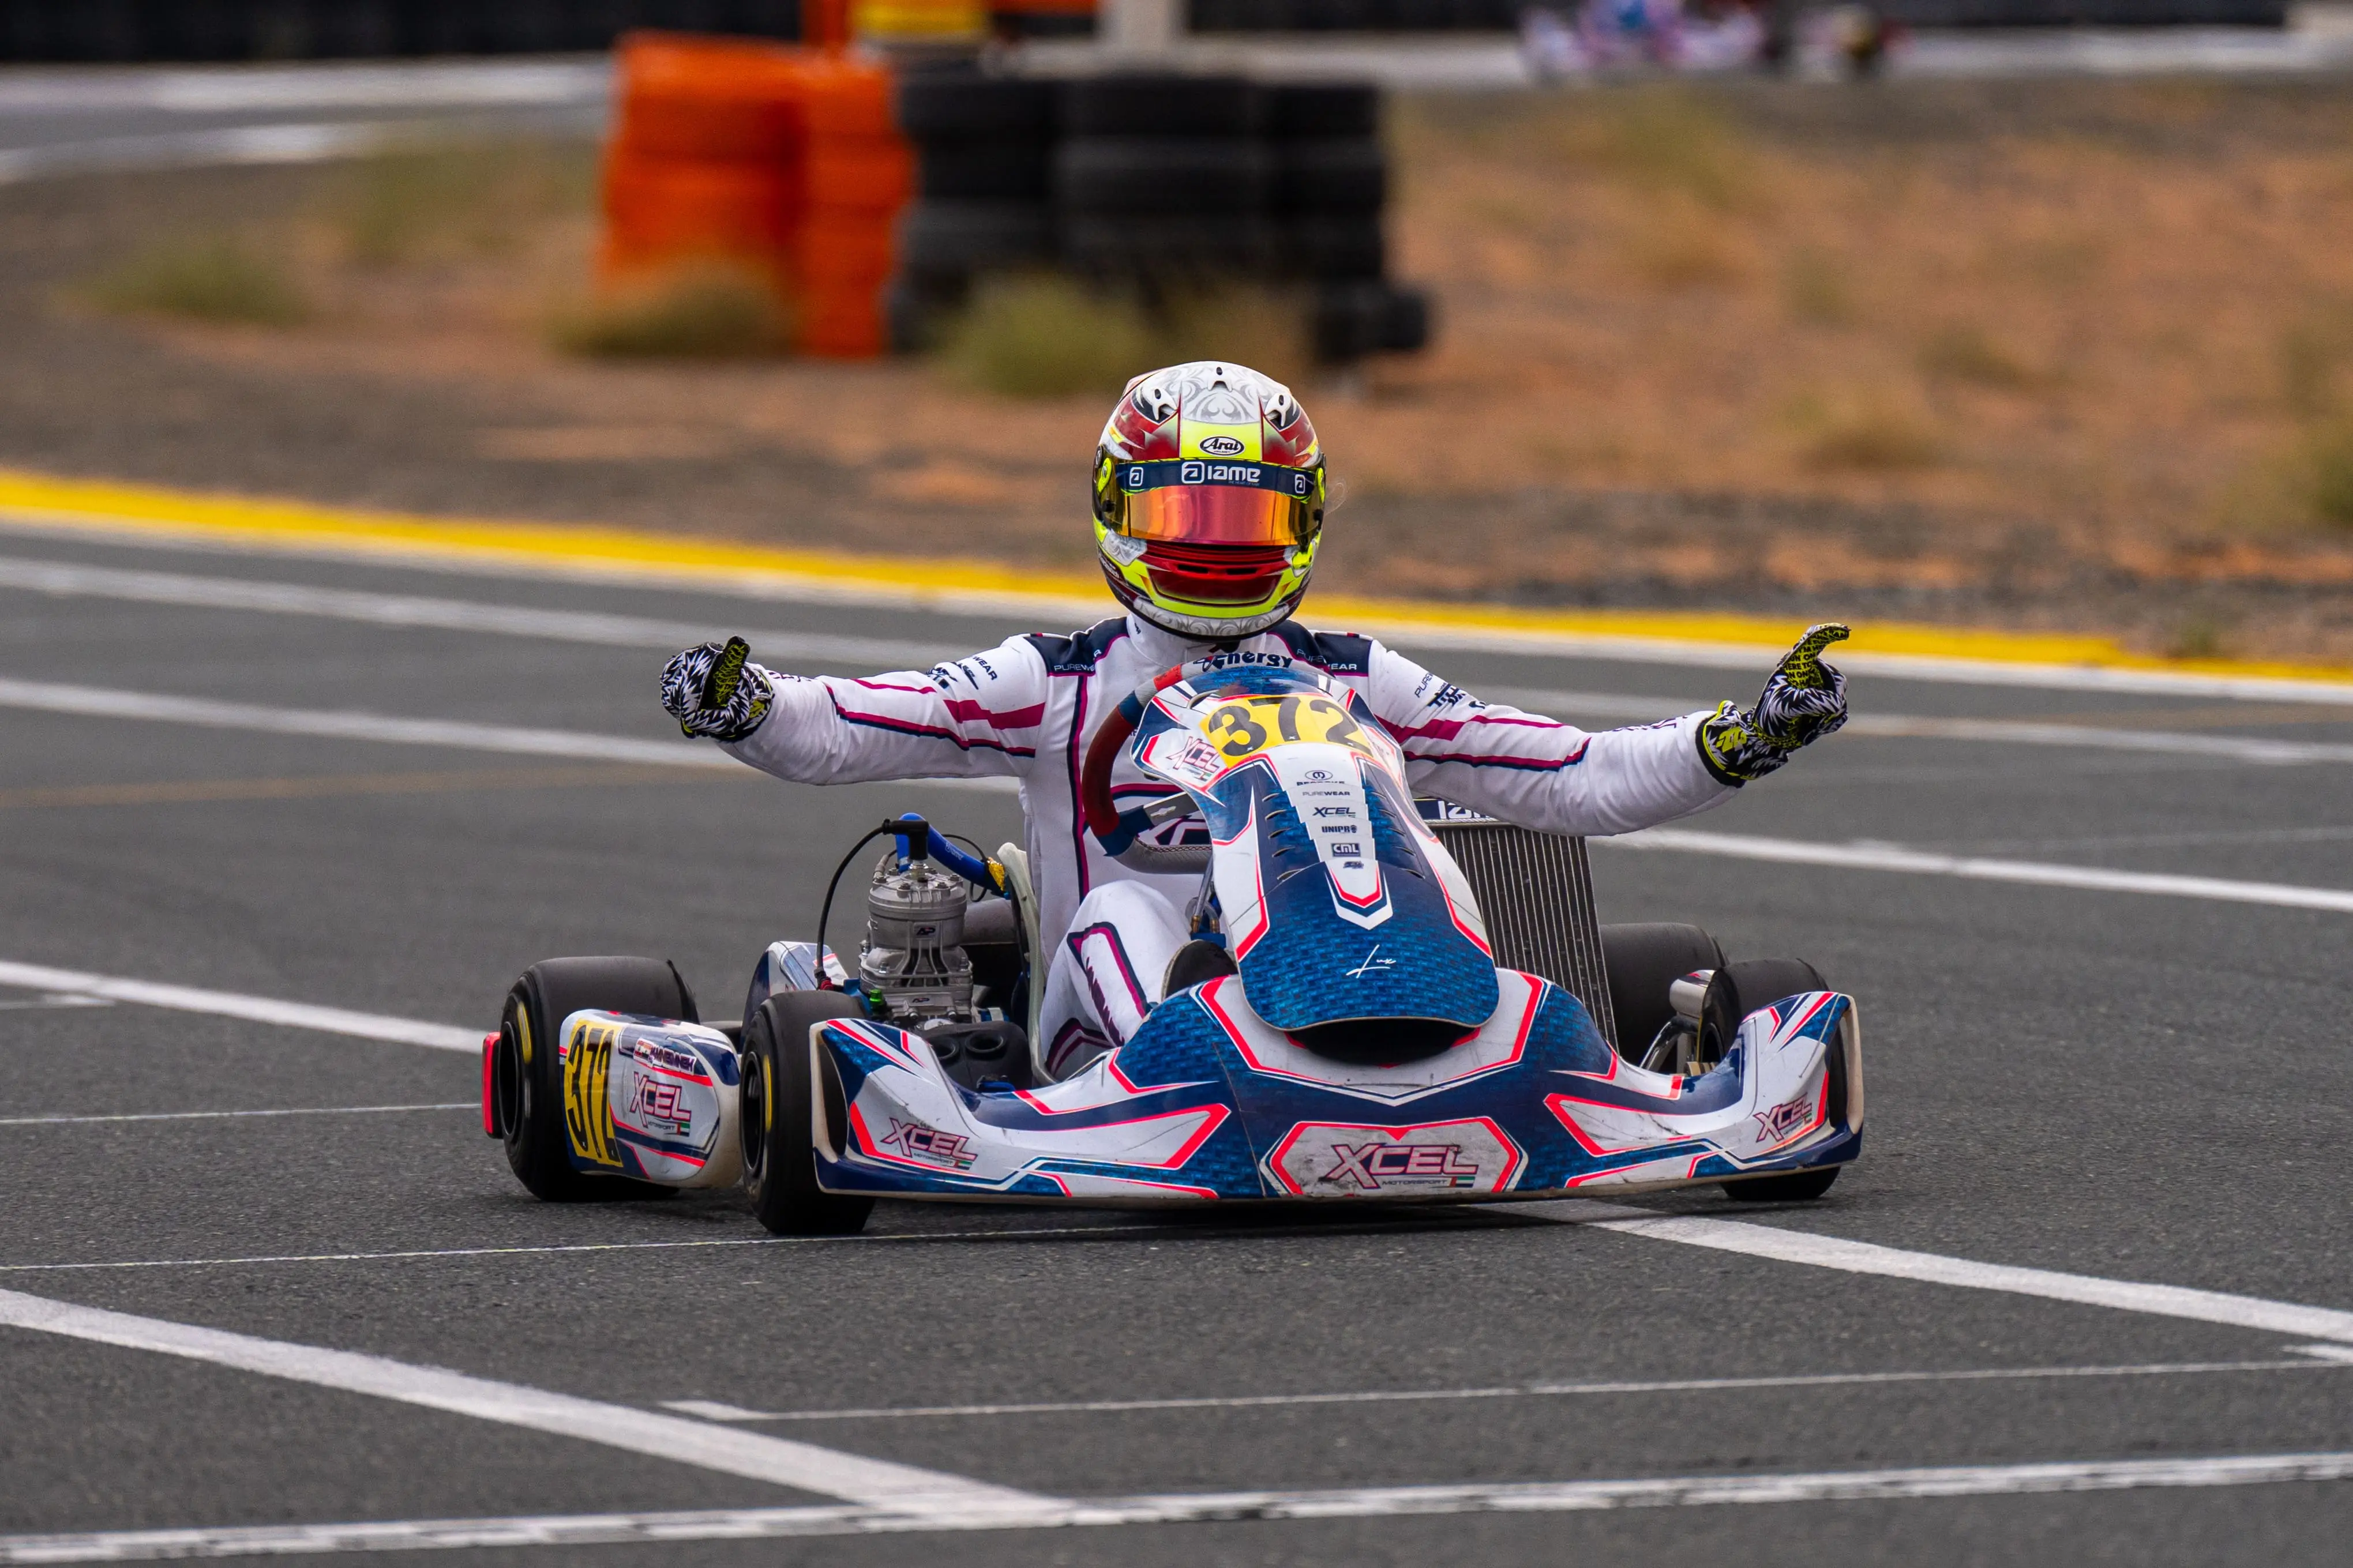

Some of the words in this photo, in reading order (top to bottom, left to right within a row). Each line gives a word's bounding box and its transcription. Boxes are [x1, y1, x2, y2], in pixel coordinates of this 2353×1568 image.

[1204, 438, 1239, 450] Arai
[1209, 697, 1374, 758] 372
[1165, 736, 1221, 773] XCEL
[1312, 807, 1356, 818] XCEL
[568, 1024, 621, 1163] 372
[629, 1071, 692, 1129] XCEL
[1752, 1092, 1812, 1143] XCEL
[880, 1117, 978, 1161] XCEL
[1326, 1142, 1479, 1190] XCEL
